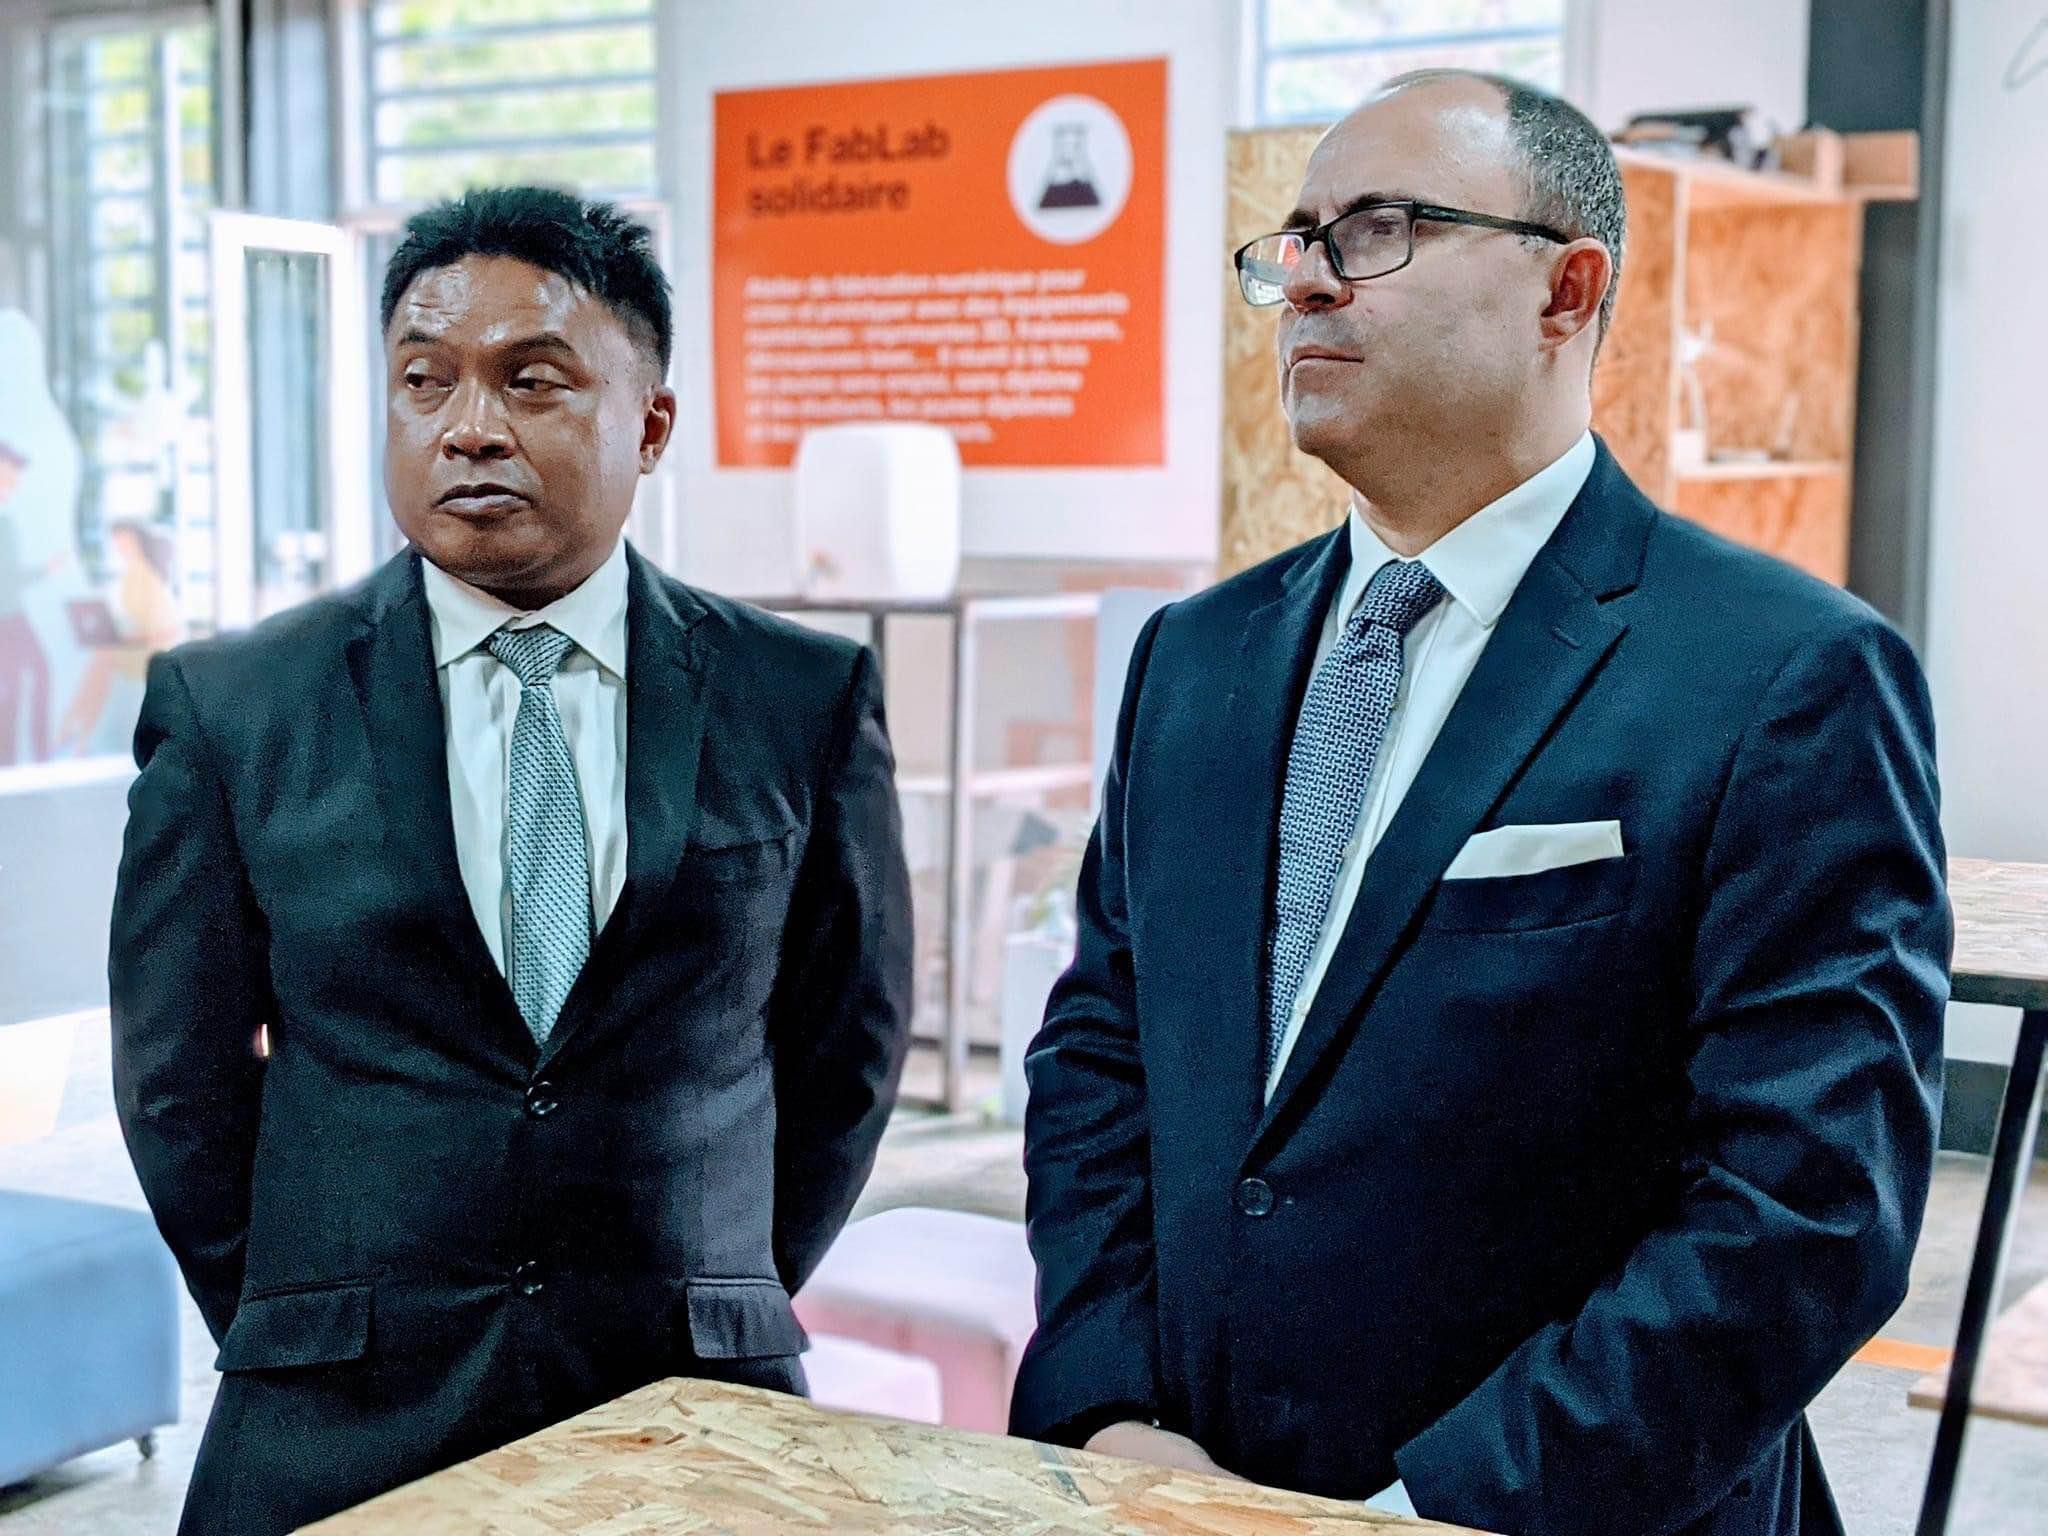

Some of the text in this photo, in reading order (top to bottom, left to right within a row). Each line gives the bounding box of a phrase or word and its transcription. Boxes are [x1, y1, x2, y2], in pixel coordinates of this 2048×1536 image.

[743, 121, 951, 173] Le FabLab
[745, 176, 911, 218] solidaire
